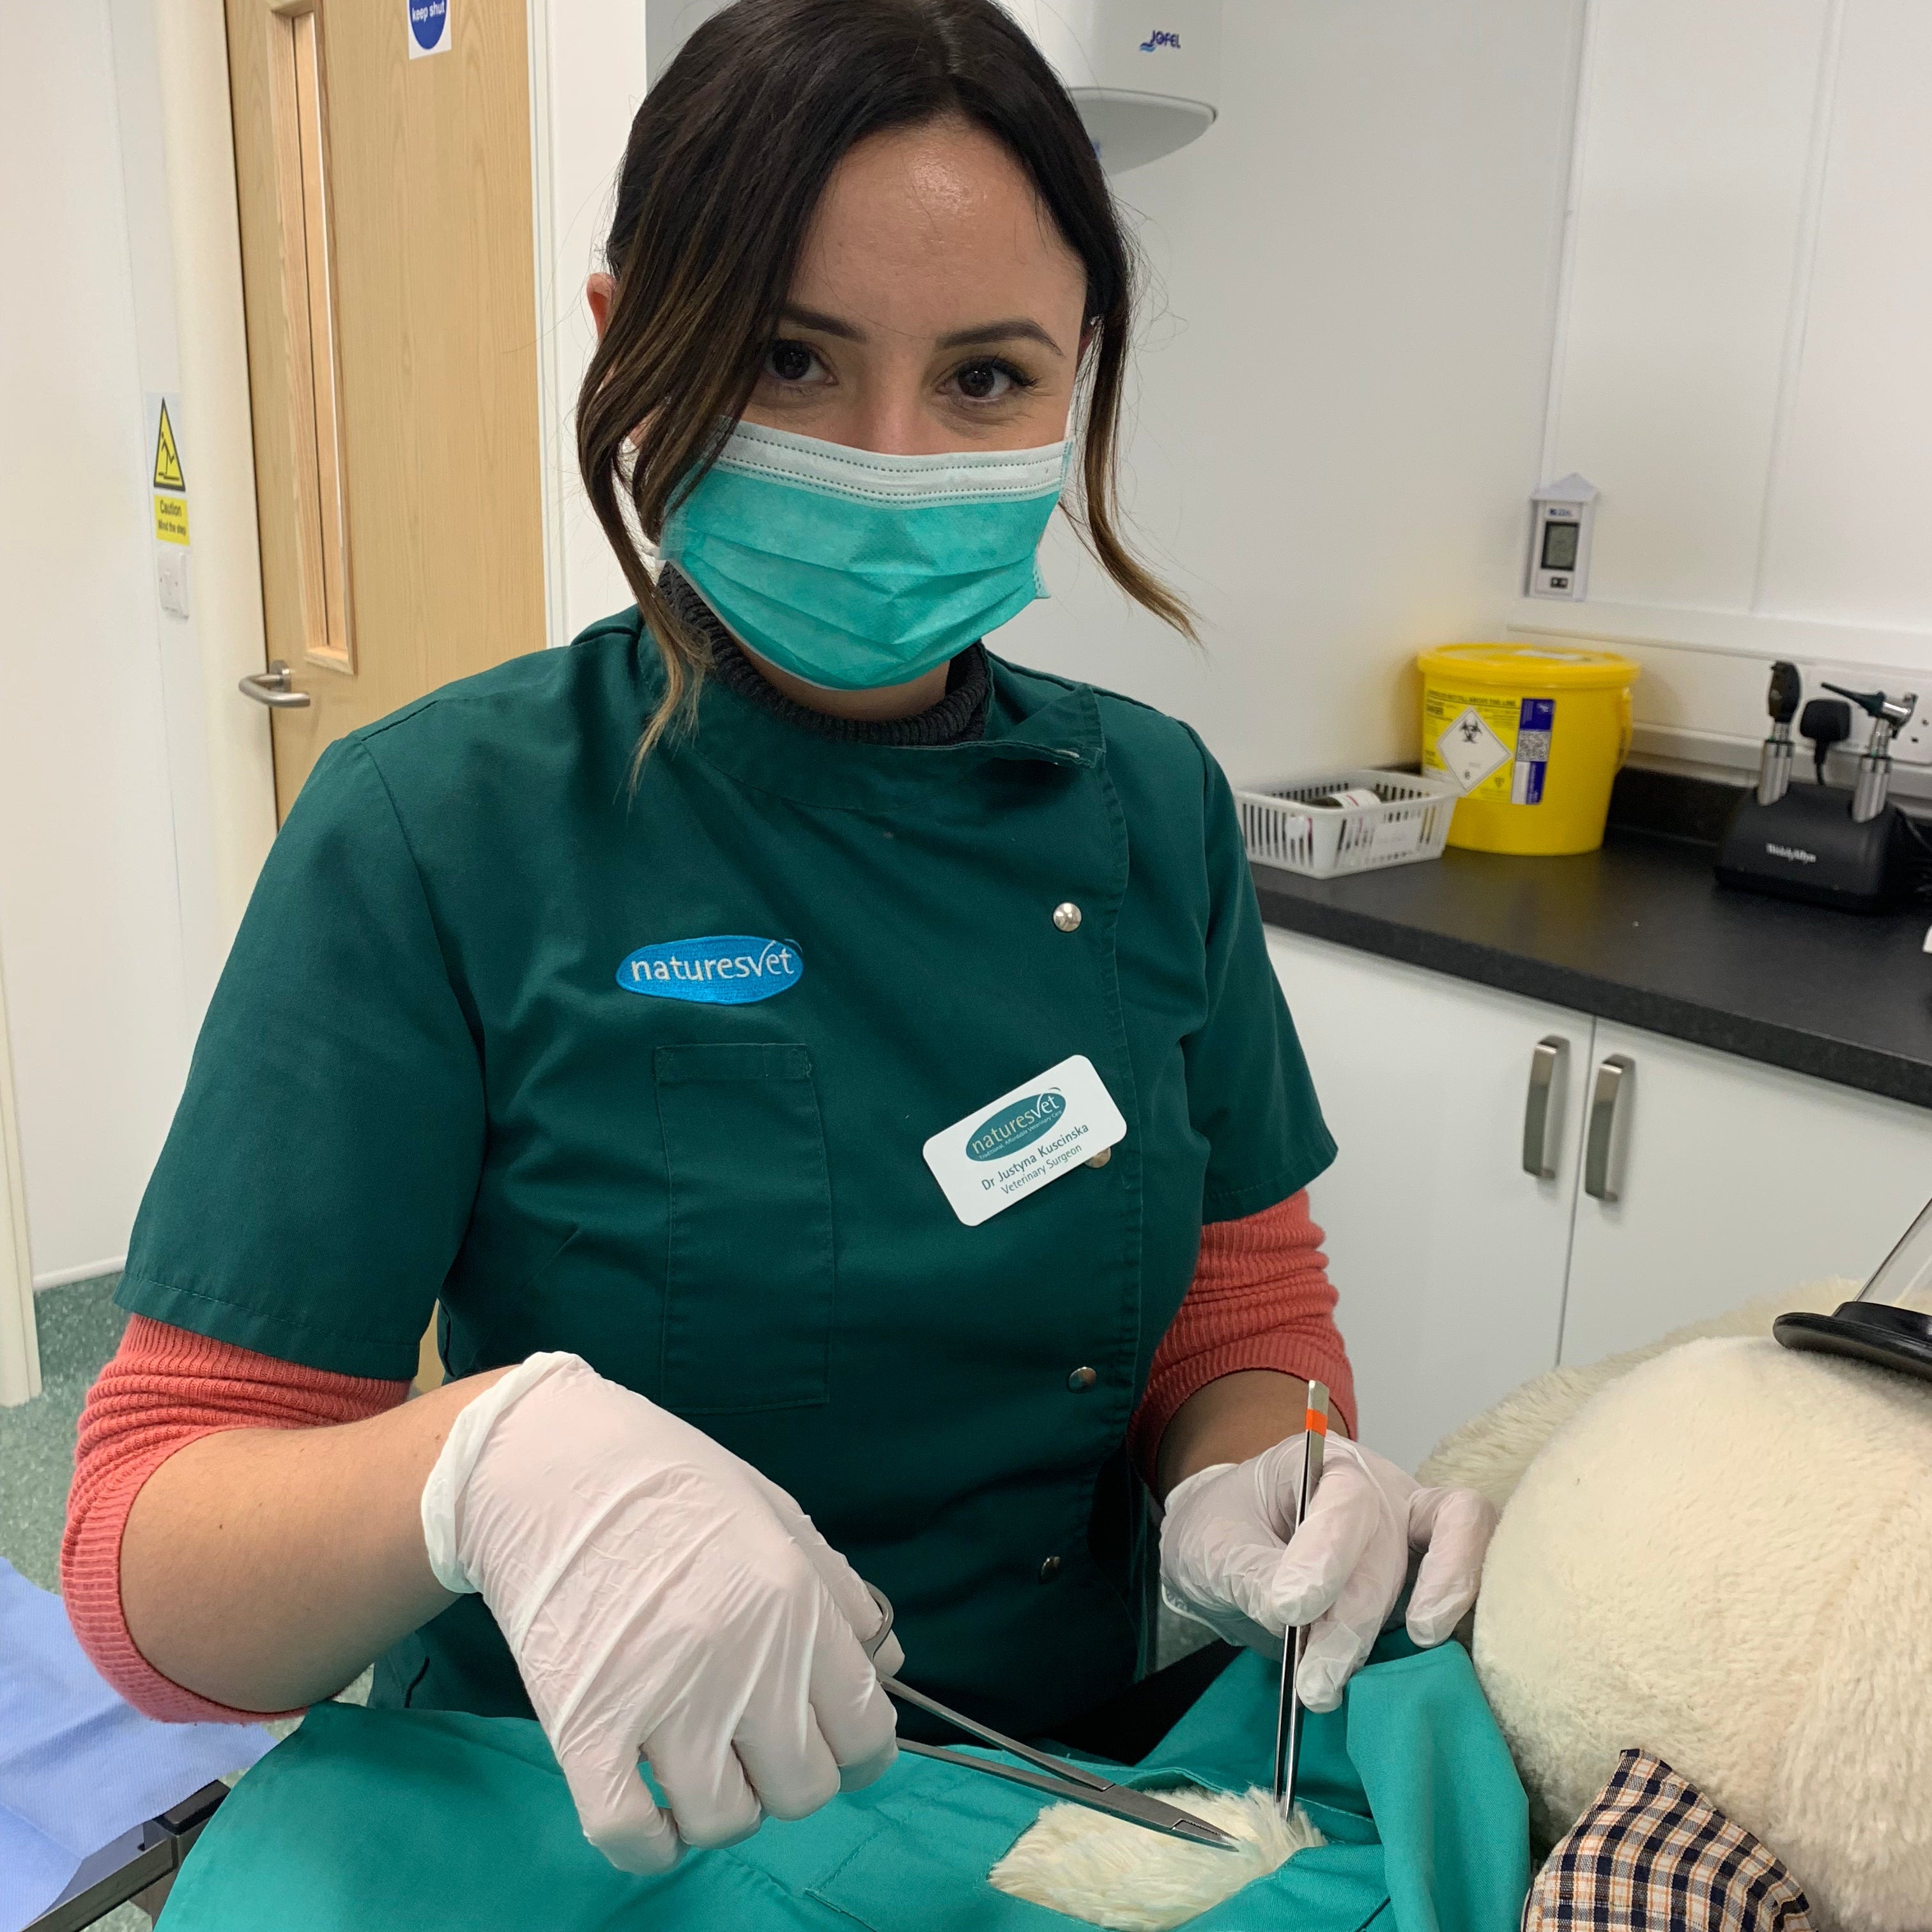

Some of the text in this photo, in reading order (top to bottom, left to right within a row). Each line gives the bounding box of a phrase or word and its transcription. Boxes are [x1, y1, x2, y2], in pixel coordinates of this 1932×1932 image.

[412, 1, 445, 23] keep shut
[1149, 29, 1181, 49] JOFEL
[158, 519, 168, 531] Mind
[177, 525, 186, 536] step
[160, 499, 182, 517] Caution
[631, 940, 794, 982] naturesvet
[972, 1093, 1059, 1154] naturesvet
[979, 1110, 1062, 1160] Traditional, Affordable Veterinary Care
[981, 1124, 1089, 1190] Dr Justyna Kuscinska
[1001, 1144, 1082, 1195] Veterinary Surgeon
